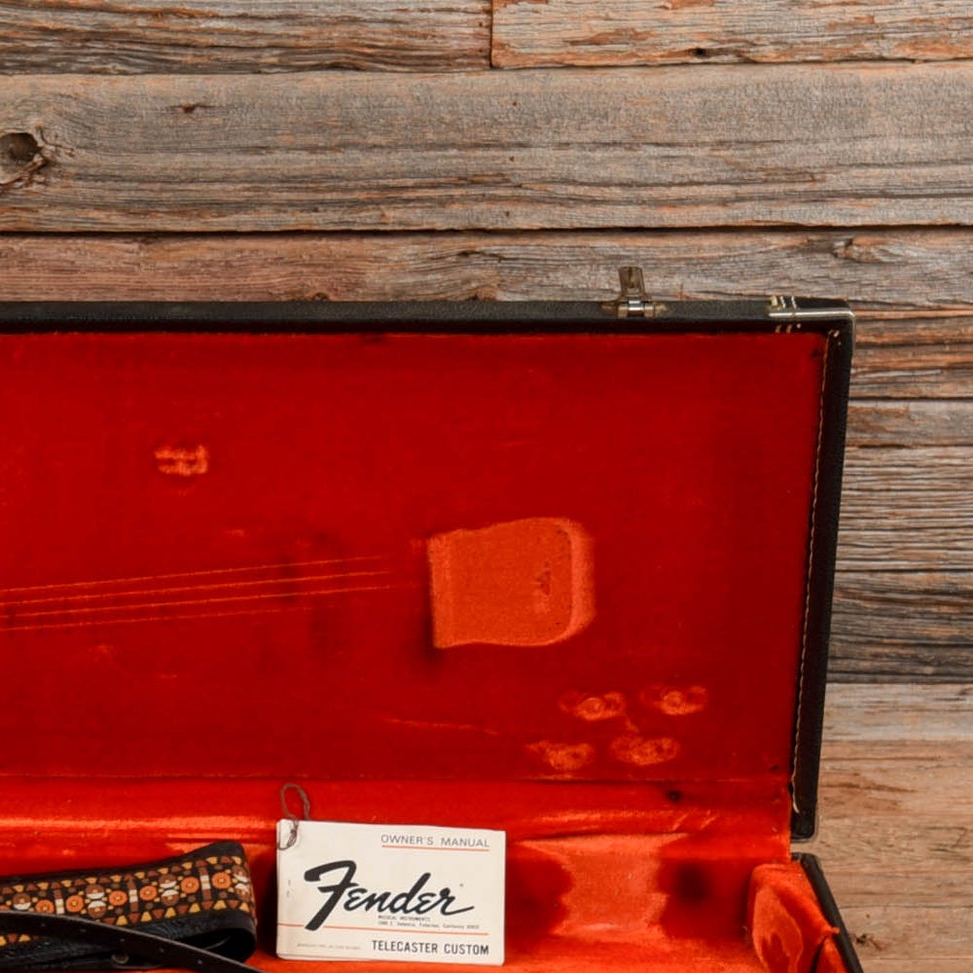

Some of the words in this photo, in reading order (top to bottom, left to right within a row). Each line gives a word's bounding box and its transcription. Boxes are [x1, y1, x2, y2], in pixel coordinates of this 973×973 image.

[440, 836, 490, 848] MANUAL
[303, 860, 475, 931] Fender
[371, 940, 438, 954] TELECASTER
[443, 943, 490, 956] CUSTOM
